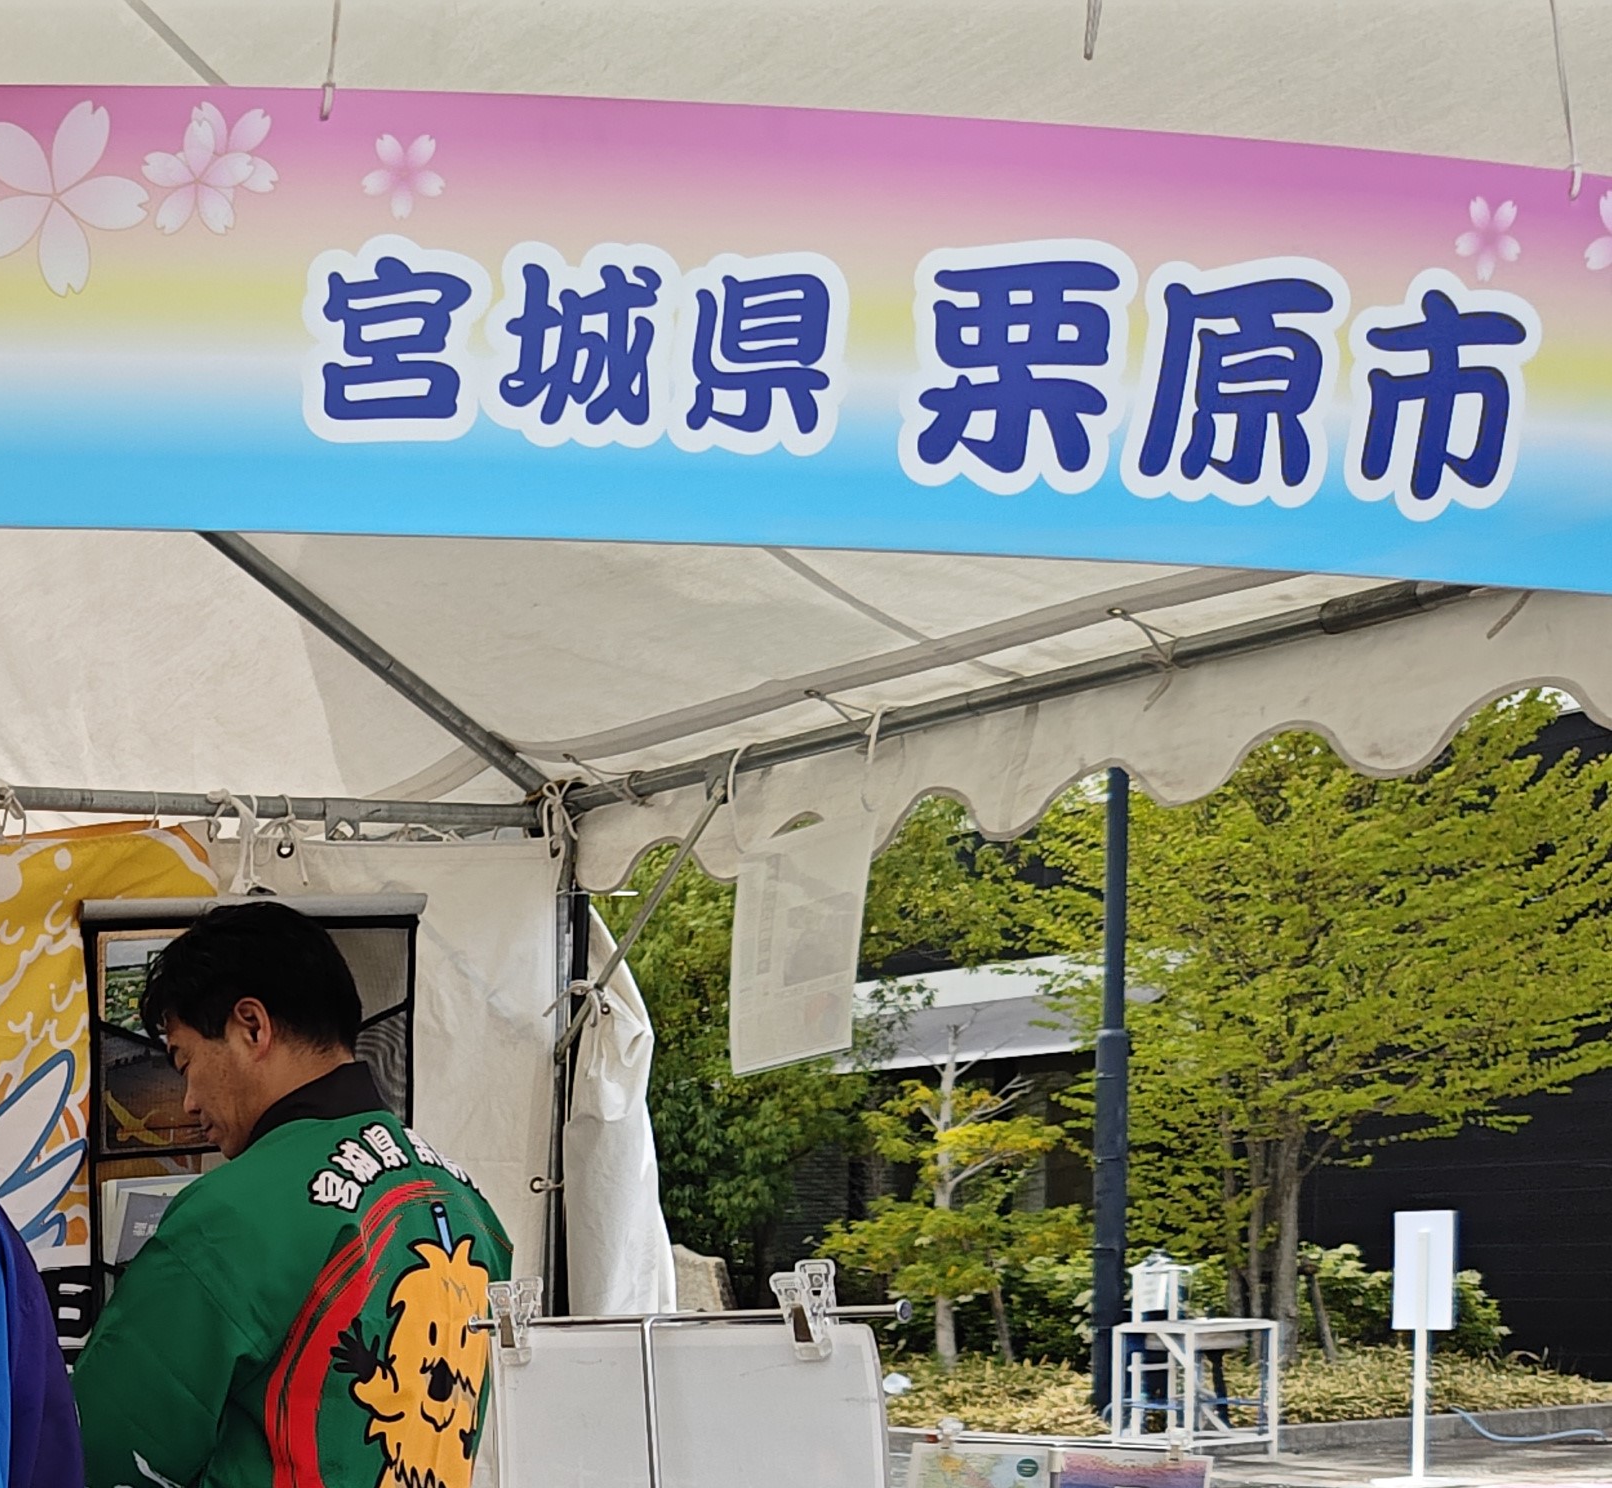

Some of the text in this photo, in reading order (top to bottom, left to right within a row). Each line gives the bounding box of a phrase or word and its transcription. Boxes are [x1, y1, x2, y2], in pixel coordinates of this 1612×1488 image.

[322, 258, 1522, 499] 宮城県 栗原市
[312, 1125, 408, 1209] 宮城県
